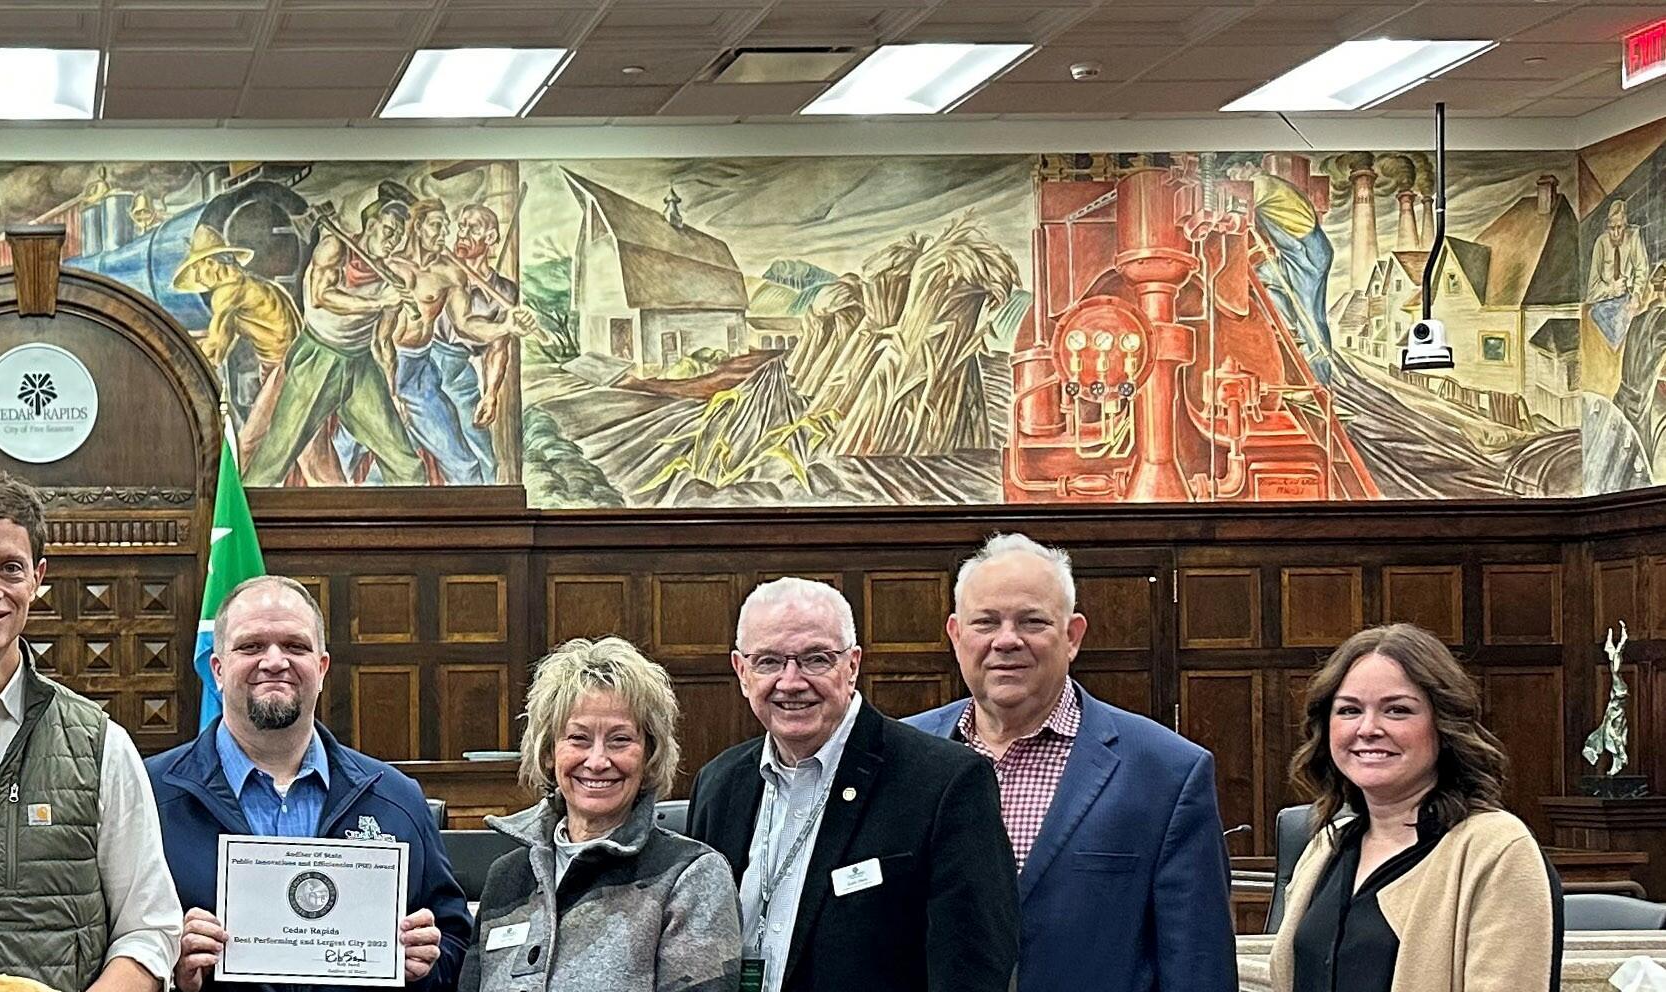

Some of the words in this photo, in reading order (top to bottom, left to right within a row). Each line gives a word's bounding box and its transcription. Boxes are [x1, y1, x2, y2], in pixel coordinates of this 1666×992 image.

[1628, 27, 1664, 76] EXIT
[43, 406, 88, 421] RAPIDS
[282, 926, 308, 935] Cedar
[310, 927, 340, 936] Rapids
[233, 936, 252, 944] Best
[253, 937, 298, 947] Performing
[316, 939, 346, 948] Largest
[347, 939, 366, 949] City
